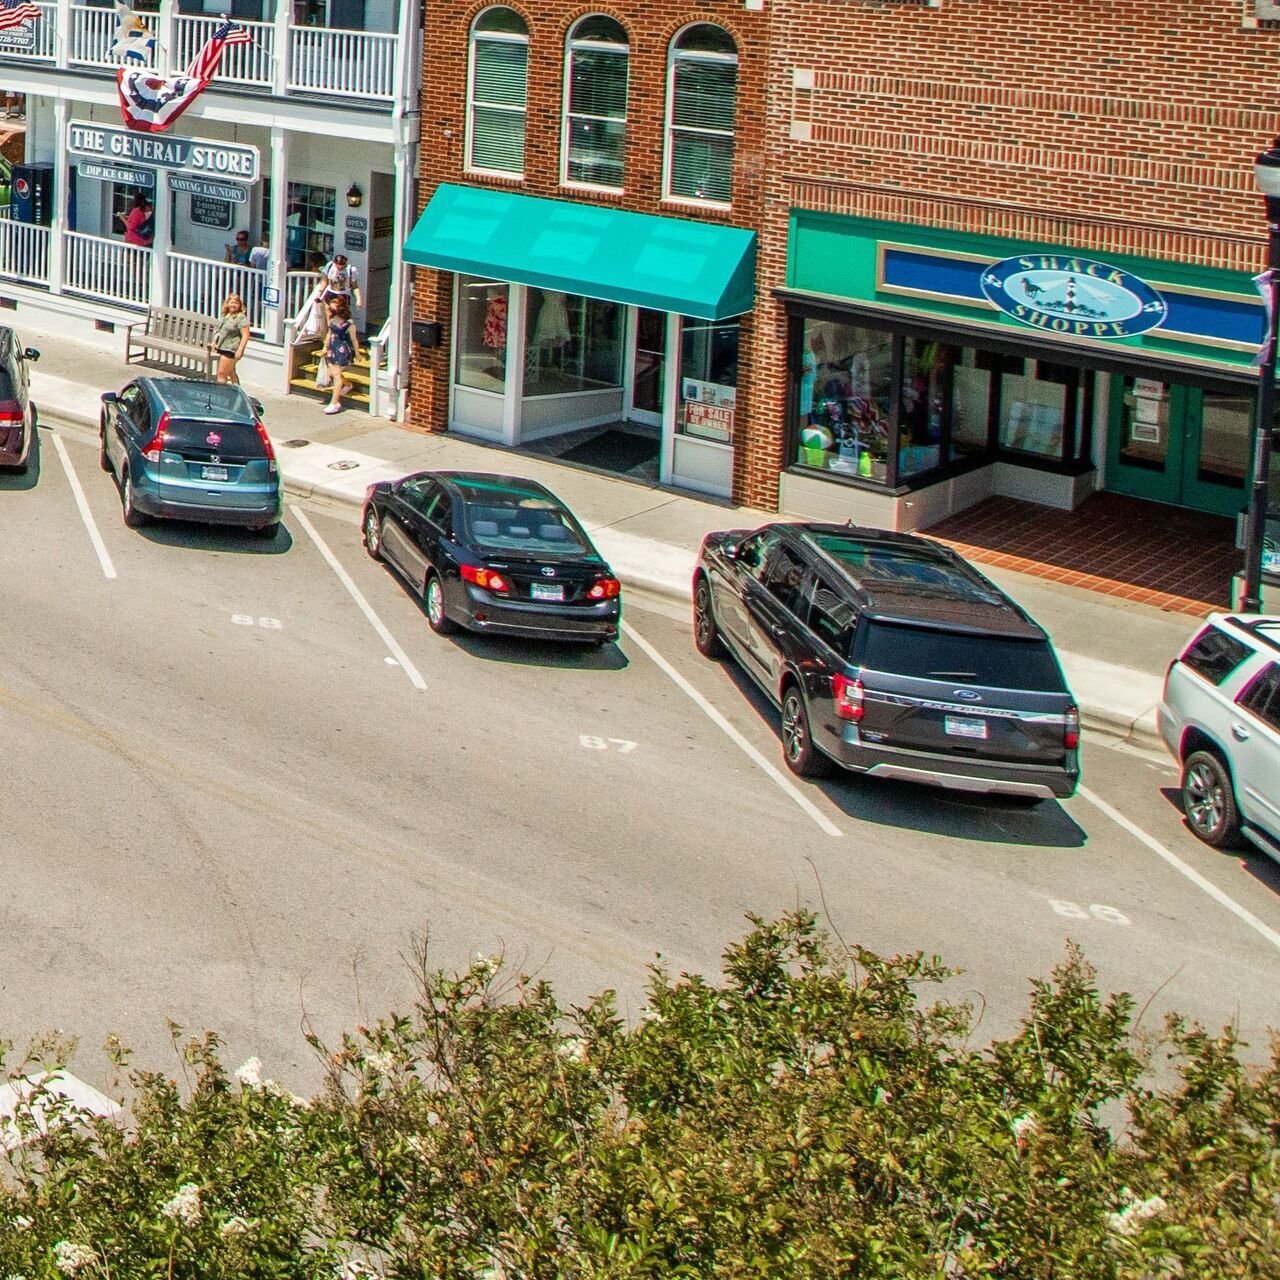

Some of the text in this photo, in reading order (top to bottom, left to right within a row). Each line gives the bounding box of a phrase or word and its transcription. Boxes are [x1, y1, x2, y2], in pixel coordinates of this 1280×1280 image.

[72, 127, 253, 175] THE GENERAL STORE
[86, 166, 146, 183] DIP ICE CREAM
[170, 178, 202, 193] MAYTAG
[203, 184, 244, 201] LAUNDRY
[1018, 256, 1126, 286] SHACK
[1011, 304, 1129, 336] SHOPPE
[689, 404, 730, 422] FOR SALE
[922, 701, 1012, 718] EXPEDITION
[578, 734, 639, 753] 87
[1047, 899, 1130, 926] 86
